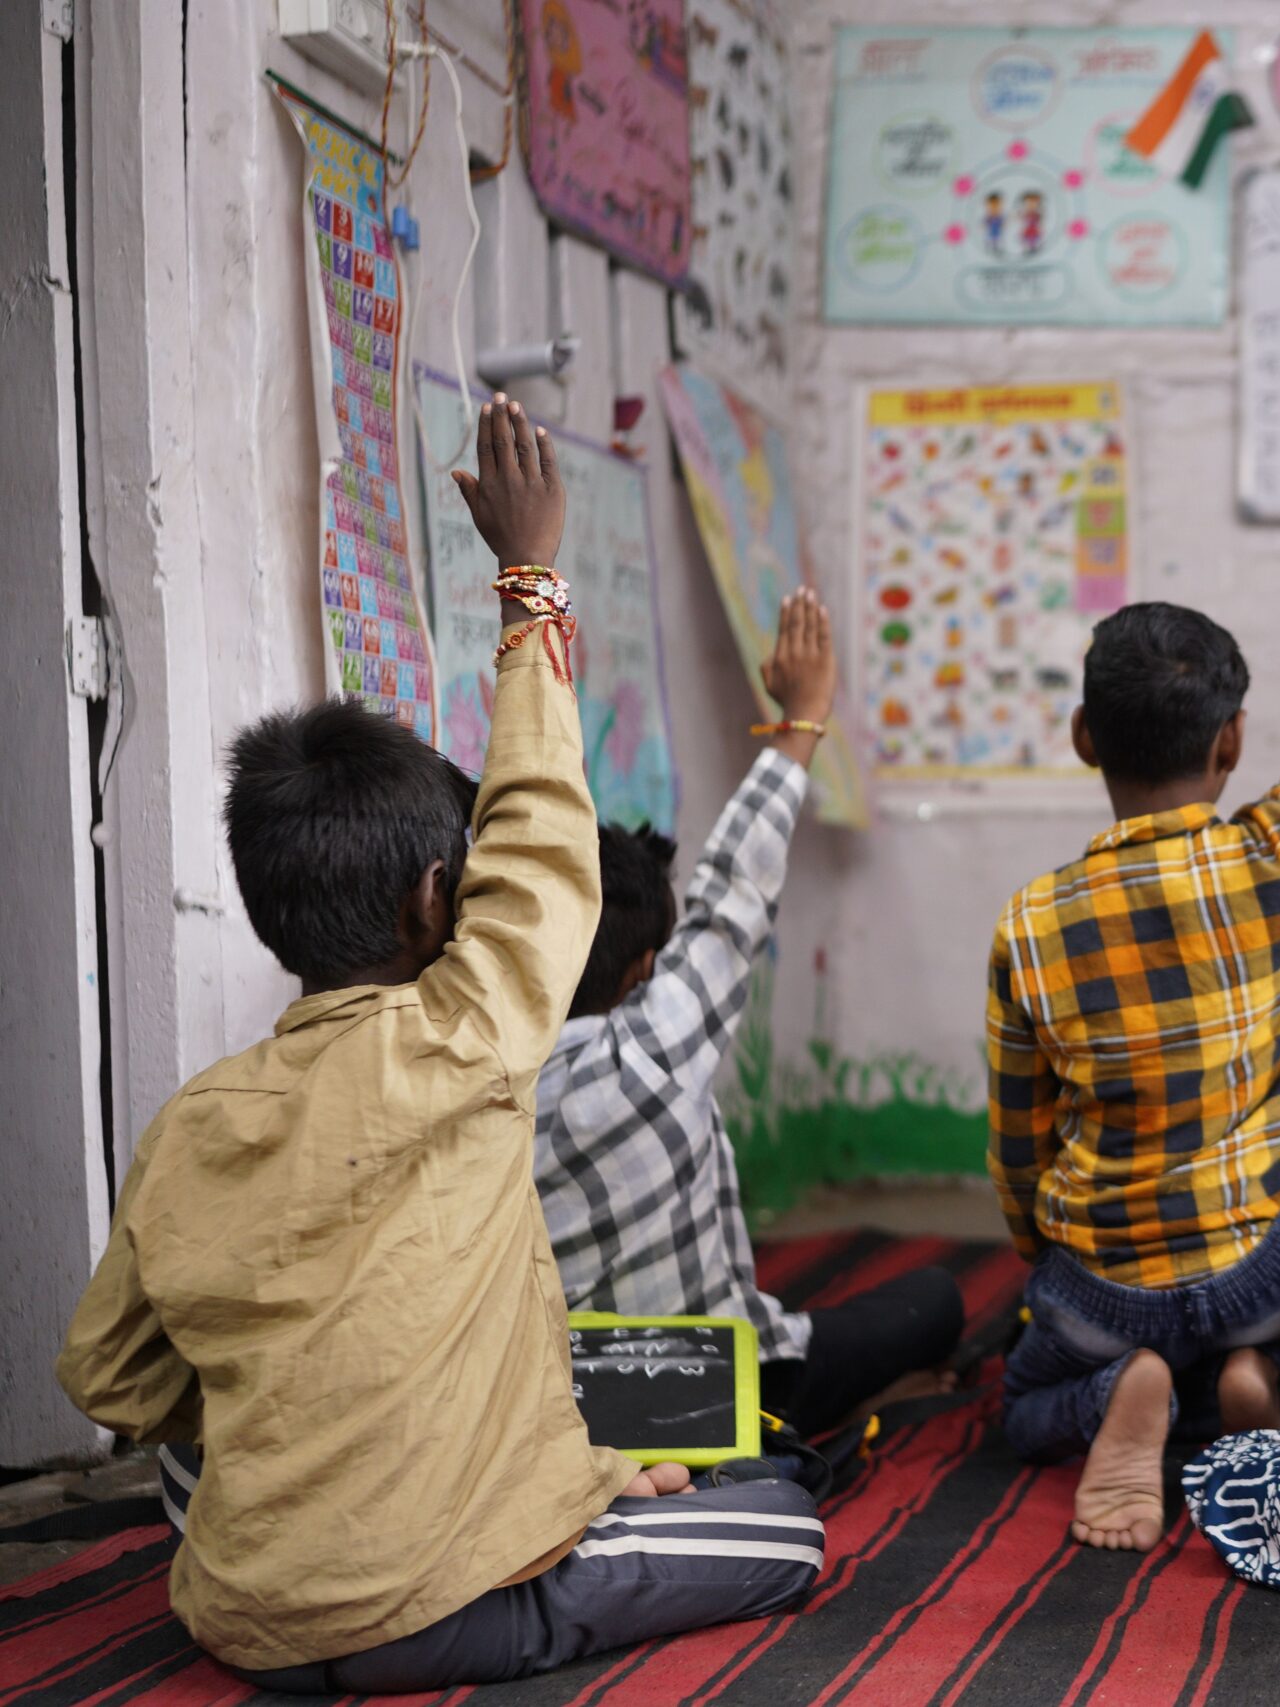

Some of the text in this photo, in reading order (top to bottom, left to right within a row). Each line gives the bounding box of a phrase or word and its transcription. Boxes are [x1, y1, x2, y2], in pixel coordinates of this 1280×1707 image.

[608, 1343, 636, 1355] M
[644, 1341, 670, 1357] N
[616, 1363, 636, 1375] U
[644, 1362, 667, 1379] V
[678, 1364, 706, 1377] W
